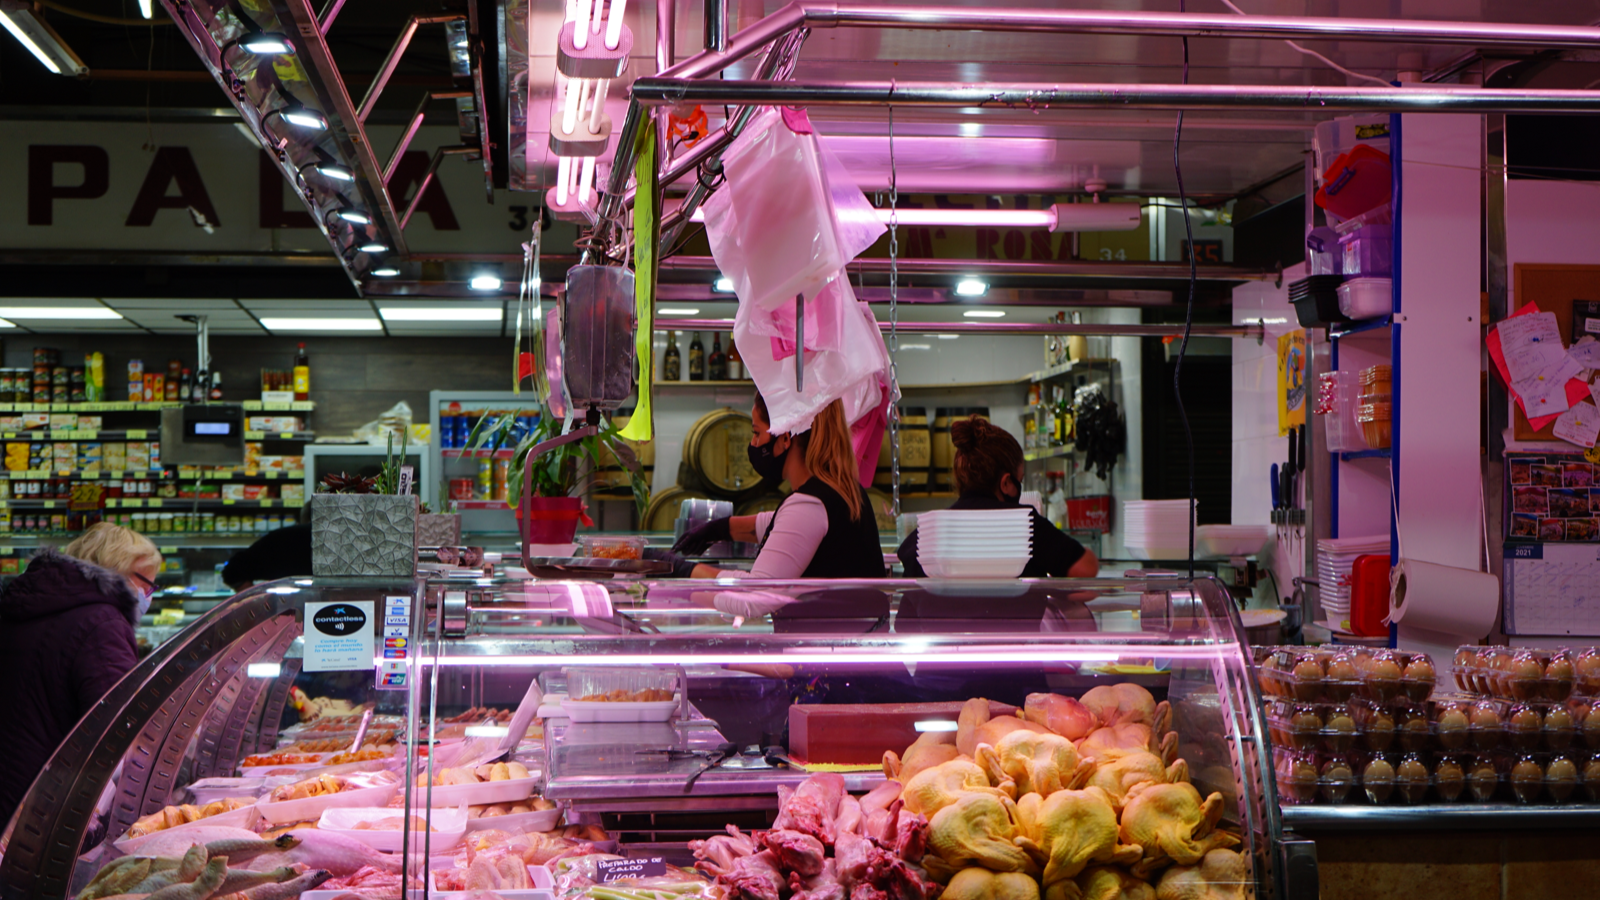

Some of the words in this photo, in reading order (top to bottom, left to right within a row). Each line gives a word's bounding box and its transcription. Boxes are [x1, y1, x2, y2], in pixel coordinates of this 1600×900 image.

[975, 227, 1074, 260] ROSA
[315, 615, 364, 624] contactless
[598, 858, 648, 869] PREPARADO
[608, 865, 643, 873] CALDO
